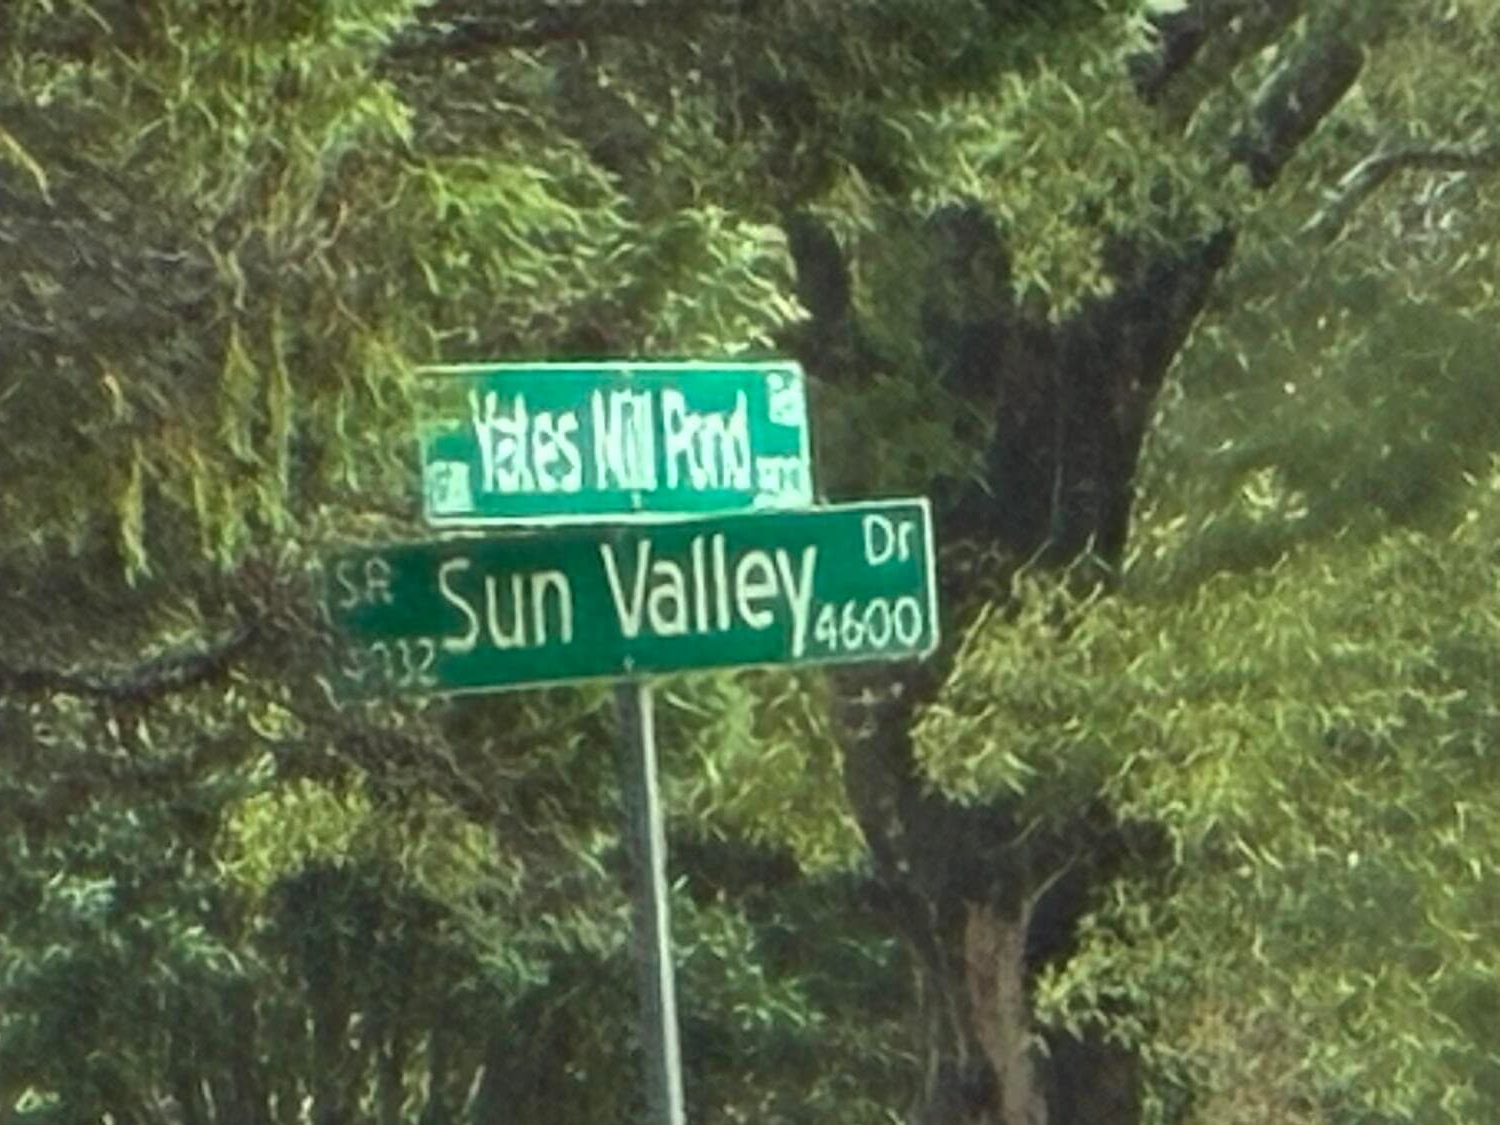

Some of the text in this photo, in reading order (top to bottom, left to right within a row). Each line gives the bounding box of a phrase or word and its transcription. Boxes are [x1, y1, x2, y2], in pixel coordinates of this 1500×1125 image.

[469, 389, 582, 492] Yates
[661, 386, 751, 491] Pond
[862, 514, 916, 566] Dr
[439, 533, 817, 658] Sun Valley
[814, 596, 922, 651] 4600
[342, 637, 438, 687] 32
